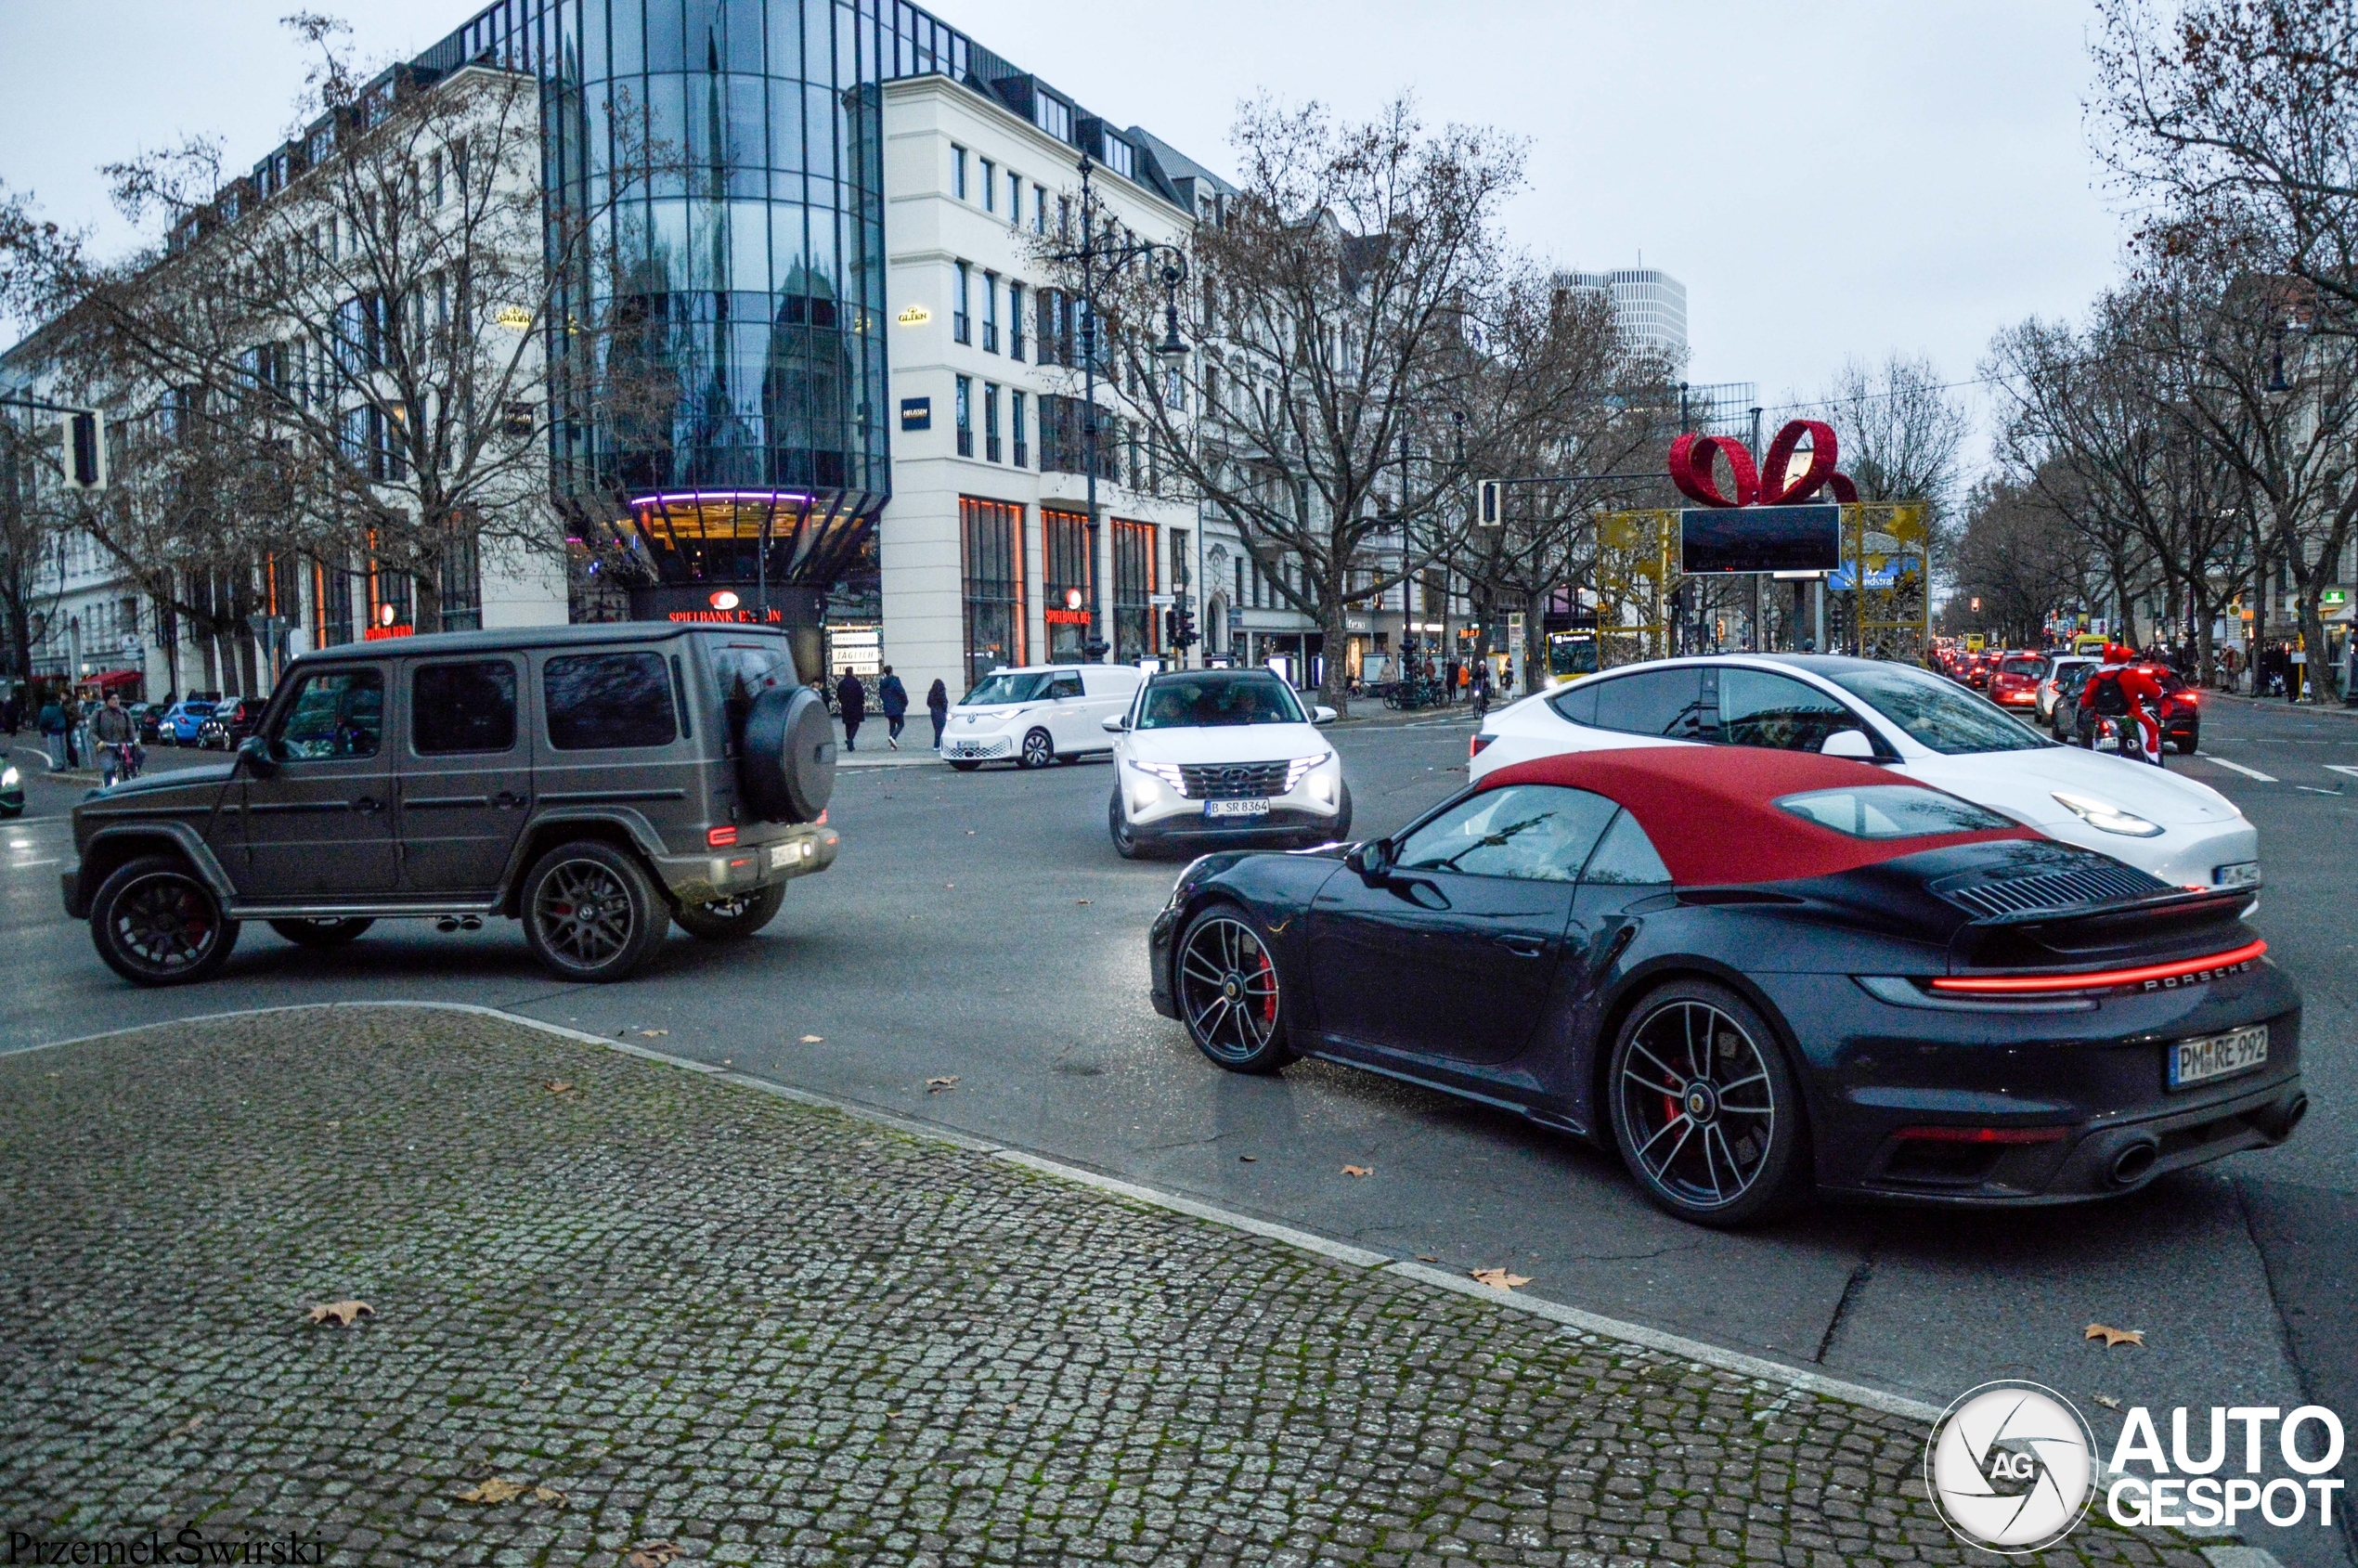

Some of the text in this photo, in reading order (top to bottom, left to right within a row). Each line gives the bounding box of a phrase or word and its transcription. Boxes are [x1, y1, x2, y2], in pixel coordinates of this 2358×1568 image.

[668, 610, 734, 623] SPIELBANK
[1045, 609, 1080, 624] SPIELBANK
[837, 650, 874, 660] TÄGLICH
[857, 665, 873, 673] UHR
[1211, 800, 1267, 813] B SR 8364
[2144, 961, 2250, 991] PORSCHE
[2180, 1030, 2265, 1078] PM RE 992
